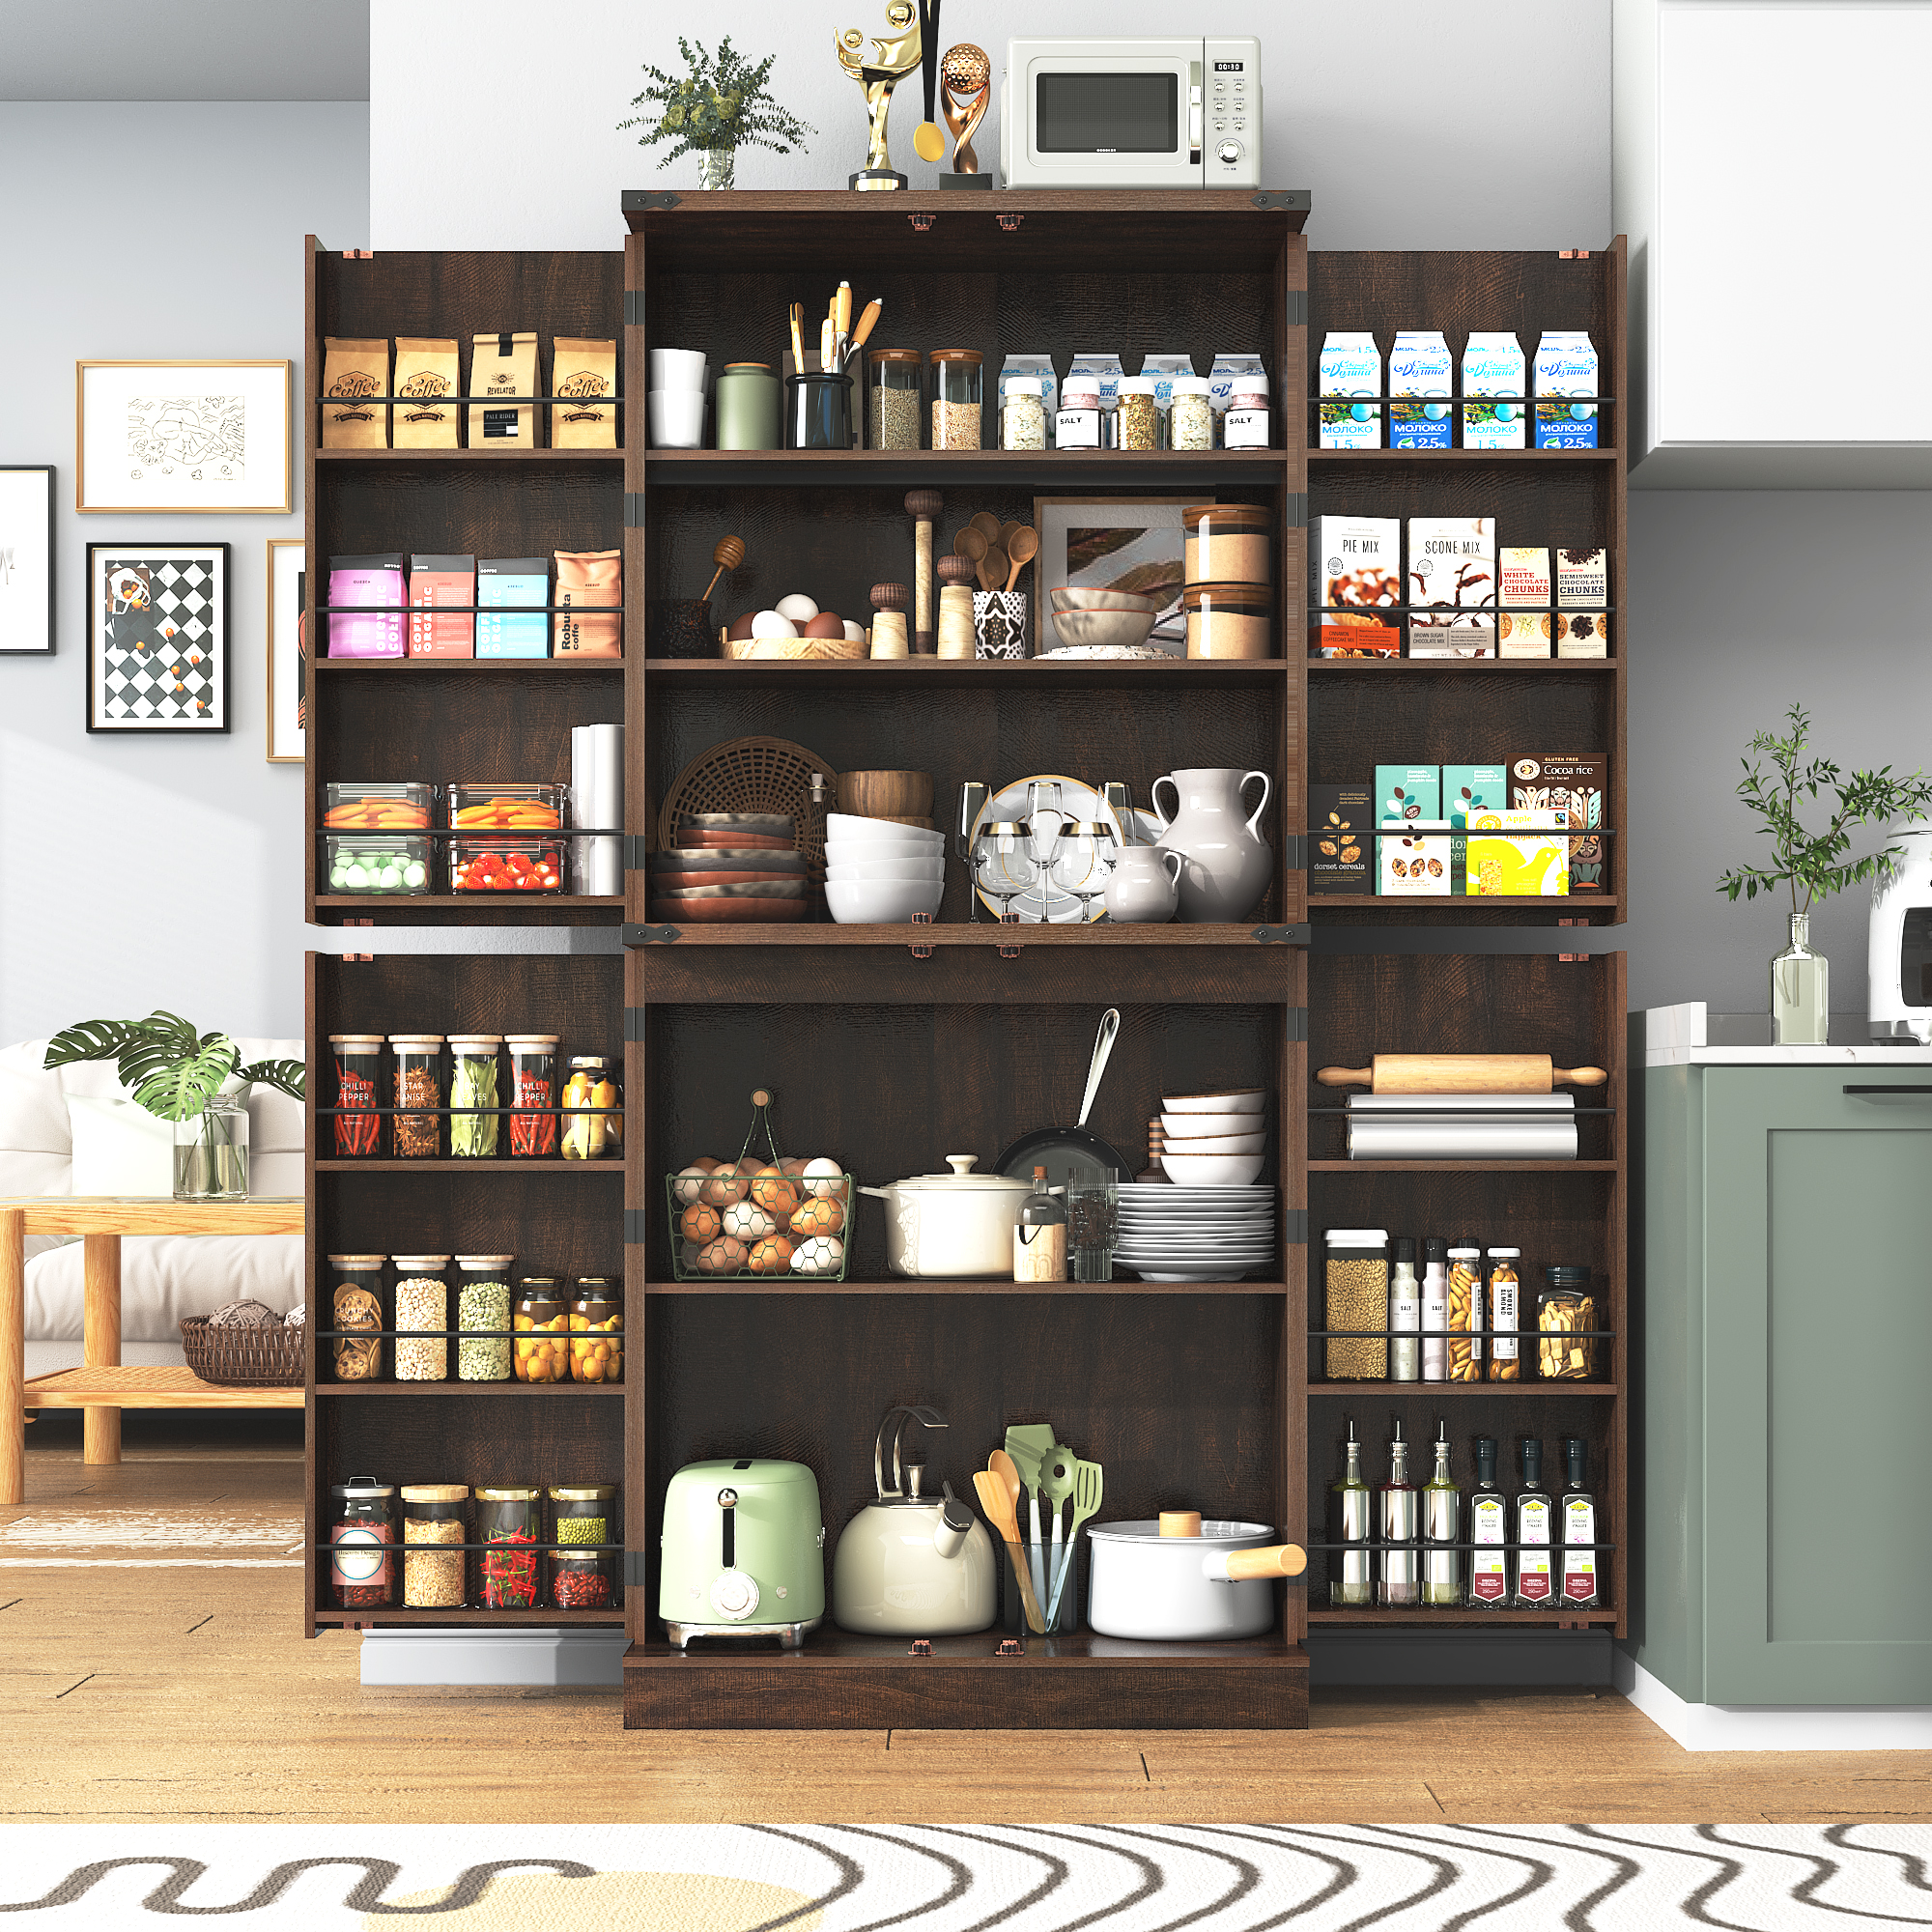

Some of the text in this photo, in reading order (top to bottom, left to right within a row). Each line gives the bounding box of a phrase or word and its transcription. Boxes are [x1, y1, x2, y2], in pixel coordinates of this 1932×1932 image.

[328, 378, 381, 398] Coffee
[399, 378, 451, 398] Coffee
[487, 386, 516, 396] REVELATOR
[557, 378, 610, 398] Coffee
[1343, 540, 1379, 554] PIE MIX
[1425, 541, 1480, 554] SCONE MIX
[412, 599, 422, 652] COFFE
[481, 601, 490, 653] COFFE
[1544, 764, 1593, 774] Cocoa rice
